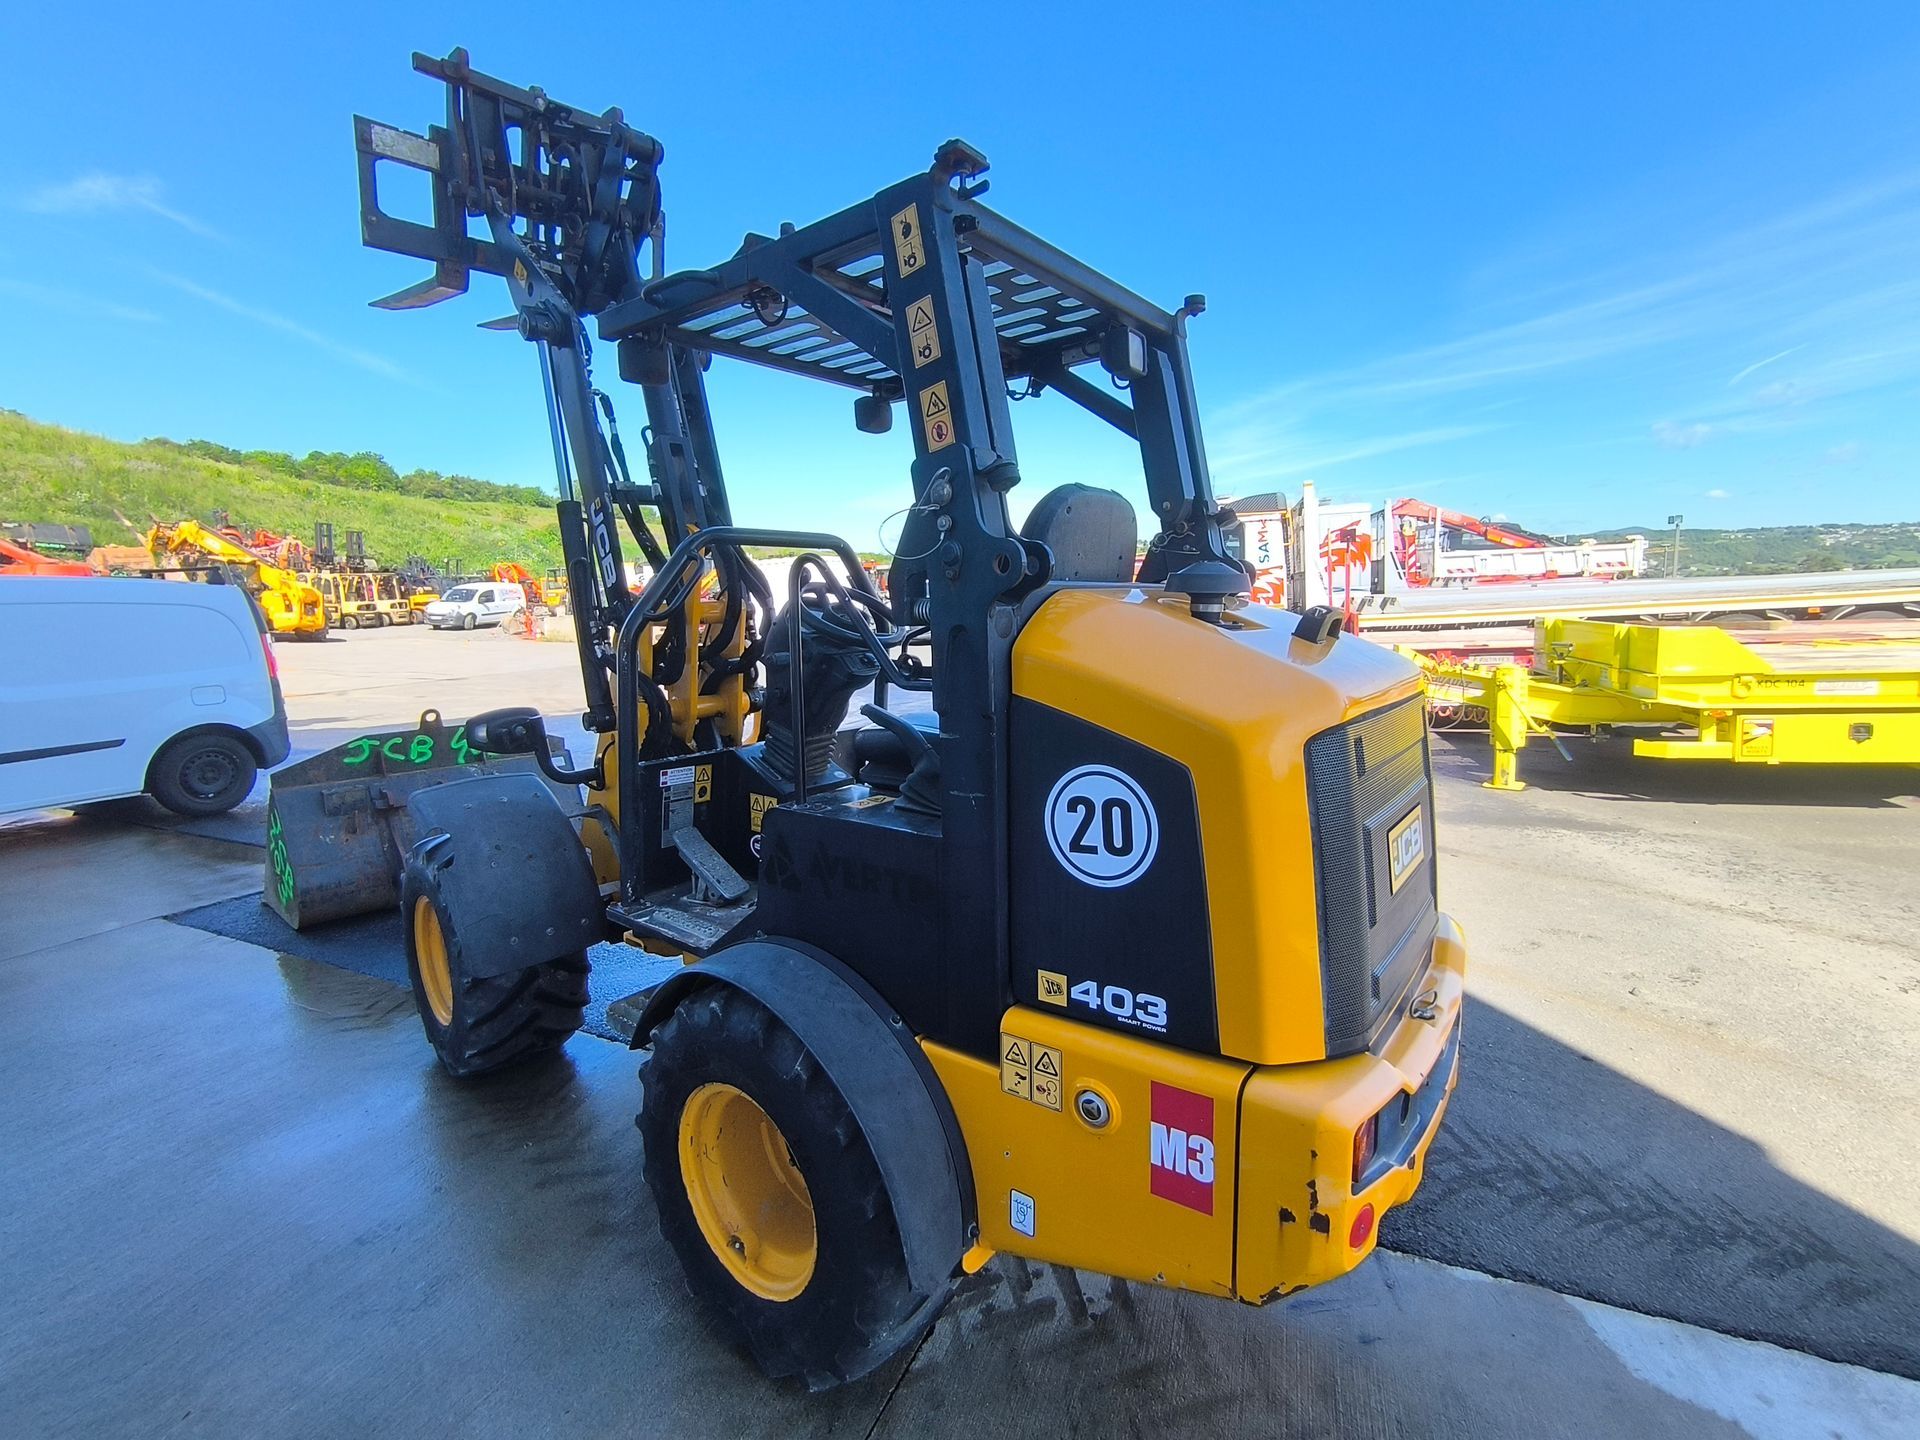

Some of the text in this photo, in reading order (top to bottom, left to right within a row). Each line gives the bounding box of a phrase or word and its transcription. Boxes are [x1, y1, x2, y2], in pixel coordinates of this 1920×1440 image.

[590, 498, 617, 589] JCB
[1757, 679, 1805, 688] KDC 104
[343, 734, 434, 764] JCB
[1066, 795, 1135, 857] 20
[1393, 819, 1421, 876] JCB
[1045, 979, 1168, 1027] JCB 403
[1117, 1016, 1167, 1033] SMART POWER
[1150, 1121, 1215, 1184] M3
